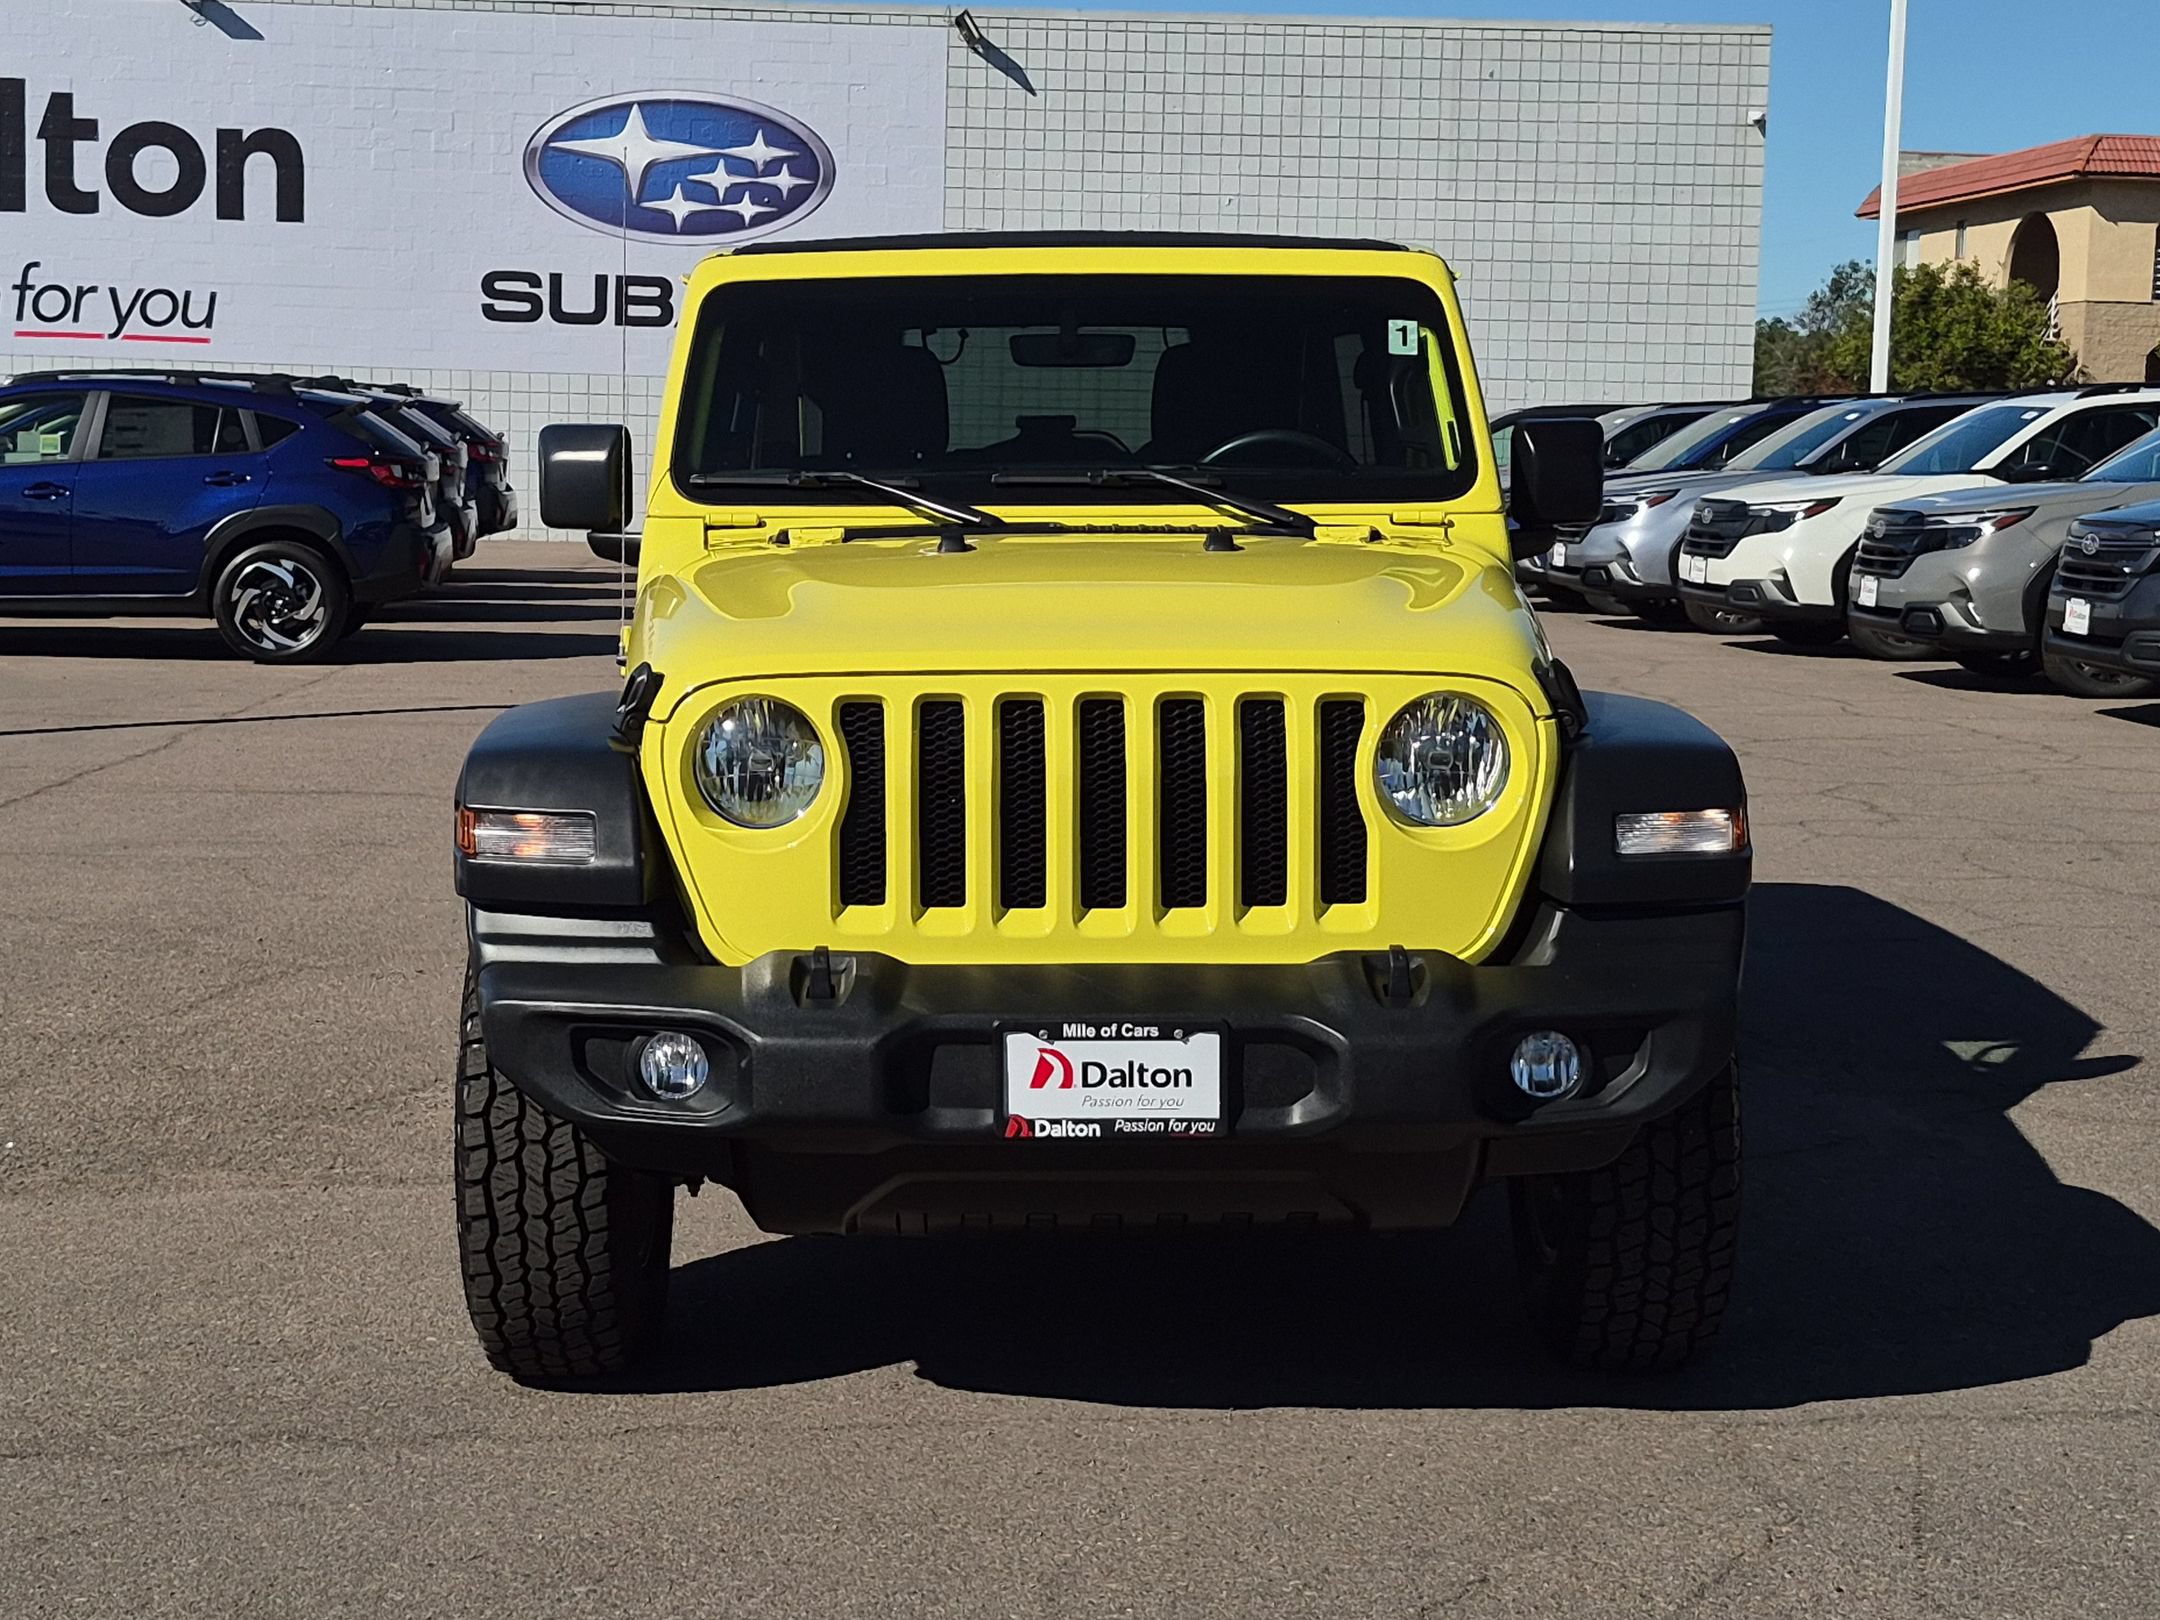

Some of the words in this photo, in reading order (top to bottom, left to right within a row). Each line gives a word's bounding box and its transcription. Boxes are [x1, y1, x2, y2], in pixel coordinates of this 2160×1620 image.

[12, 261, 99, 324] for
[107, 286, 218, 340] you
[481, 270, 678, 328] SUB
[1395, 325, 1408, 347] 1
[1063, 1023, 1096, 1038] Mile
[1100, 1023, 1117, 1038] of
[1121, 1023, 1160, 1038] Cars
[1081, 1060, 1193, 1089] Dalton
[1081, 1095, 1133, 1108] Passion
[1137, 1095, 1156, 1107] for
[1159, 1098, 1184, 1108] you
[1034, 1119, 1101, 1138] Dalton
[1114, 1119, 1164, 1133] Passion
[1168, 1119, 1188, 1132] for
[1189, 1121, 1216, 1135] you
